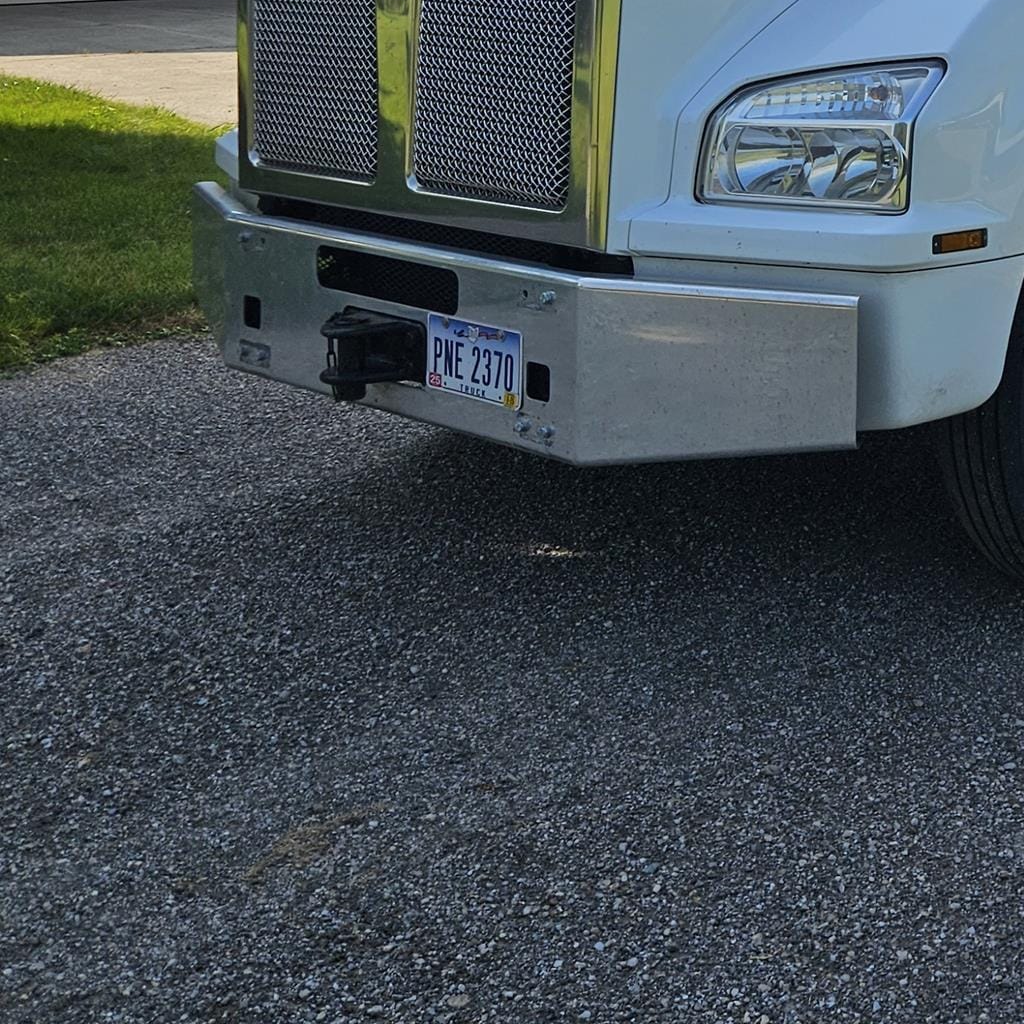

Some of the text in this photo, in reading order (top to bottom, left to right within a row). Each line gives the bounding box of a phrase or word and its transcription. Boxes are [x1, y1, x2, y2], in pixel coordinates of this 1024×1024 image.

[433, 336, 514, 393] PNE 2370
[429, 374, 441, 385] 25
[459, 383, 486, 397] TRUCK
